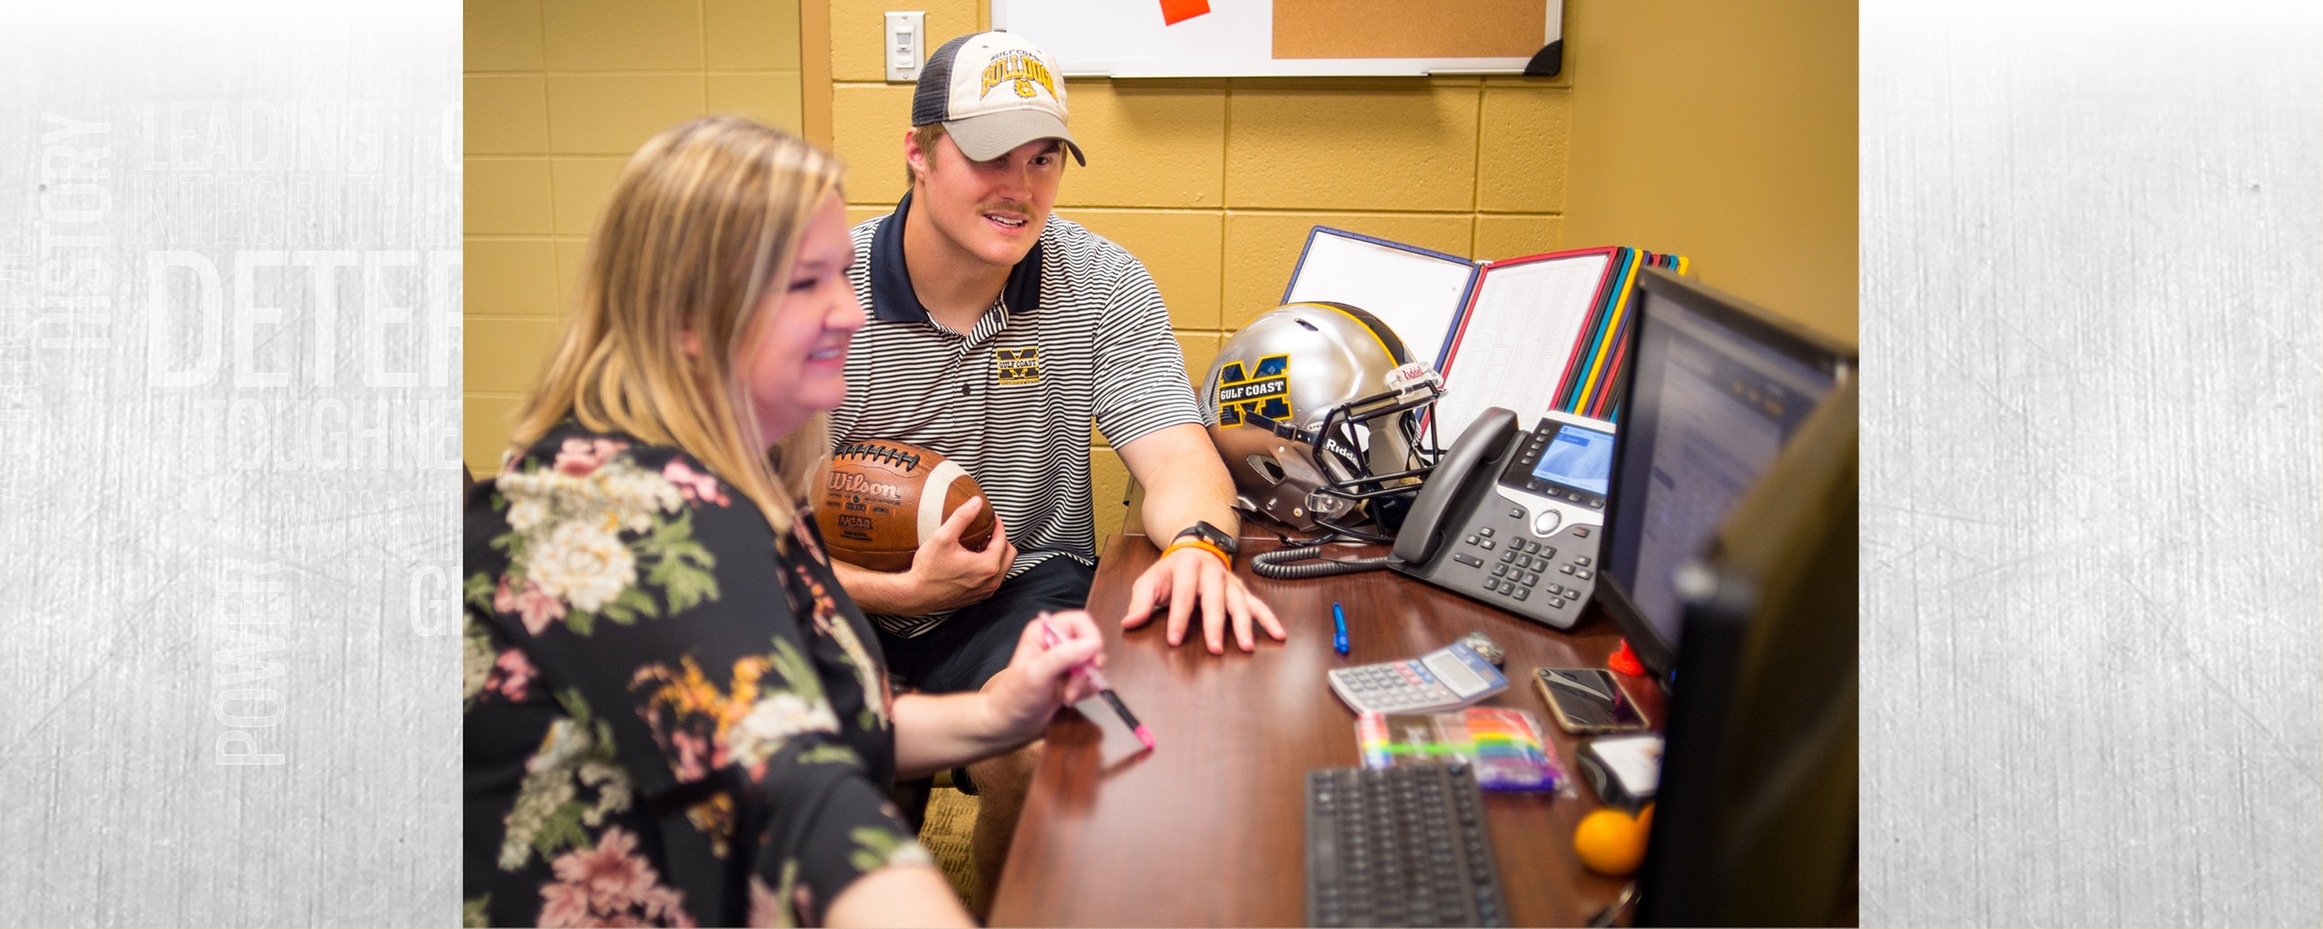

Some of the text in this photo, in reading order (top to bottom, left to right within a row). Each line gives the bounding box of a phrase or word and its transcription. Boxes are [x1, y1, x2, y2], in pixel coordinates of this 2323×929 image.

[1220, 381, 1284, 400] GULF COAST
[828, 472, 898, 500] Wilson
[839, 515, 873, 530] NCAA
